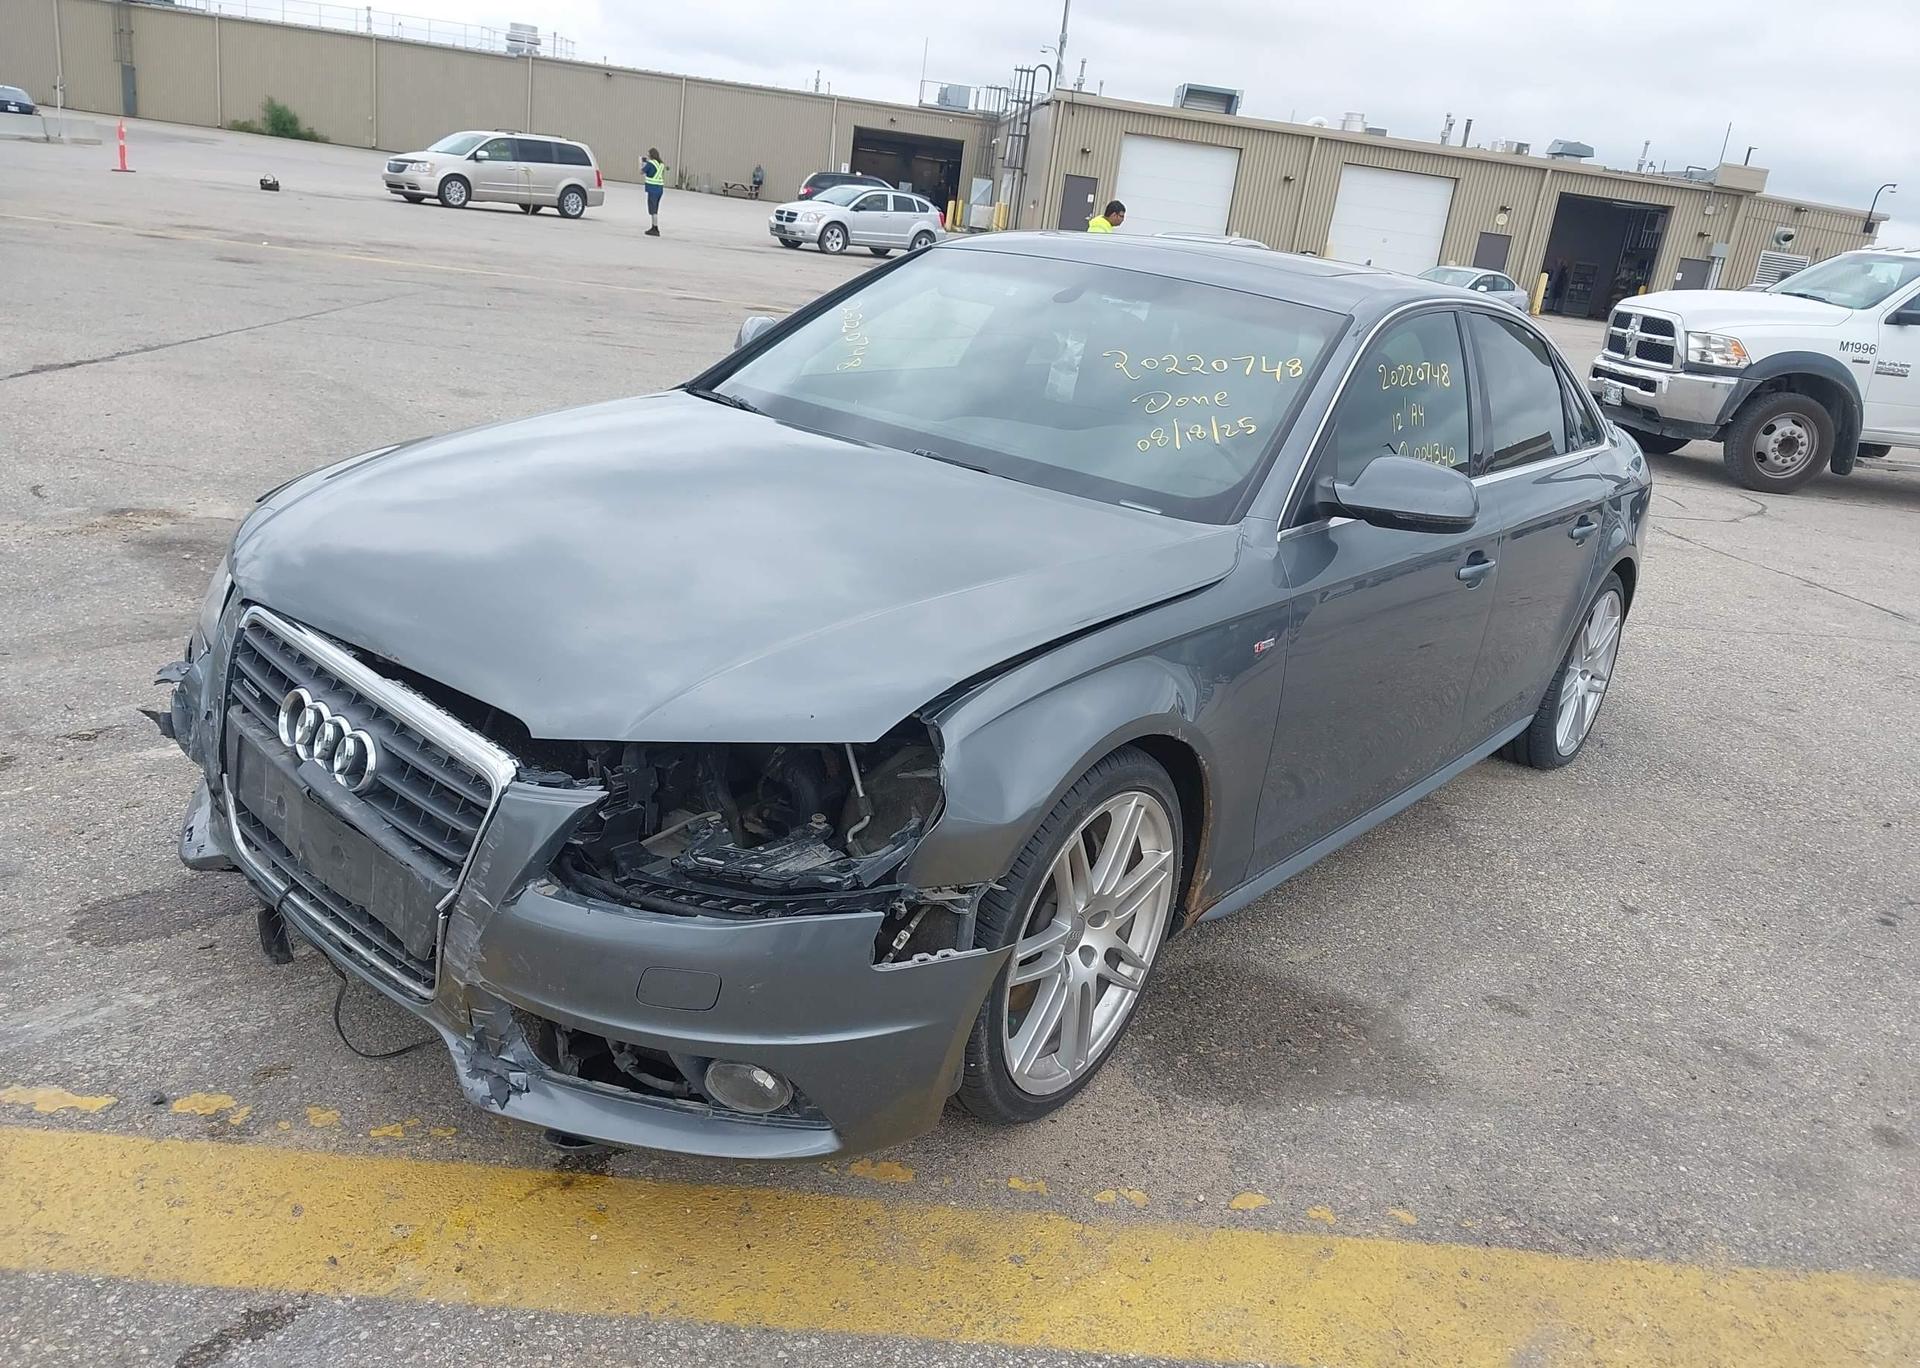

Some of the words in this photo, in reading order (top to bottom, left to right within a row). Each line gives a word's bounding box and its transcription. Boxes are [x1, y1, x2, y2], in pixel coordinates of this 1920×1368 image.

[1839, 341, 1878, 355] M1996
[1102, 350, 1304, 382] 20220748
[1378, 361, 1451, 390] 20220748
[1131, 390, 1231, 414] Done
[1411, 403, 1425, 427] A4
[1136, 416, 1257, 451] 08/18/25
